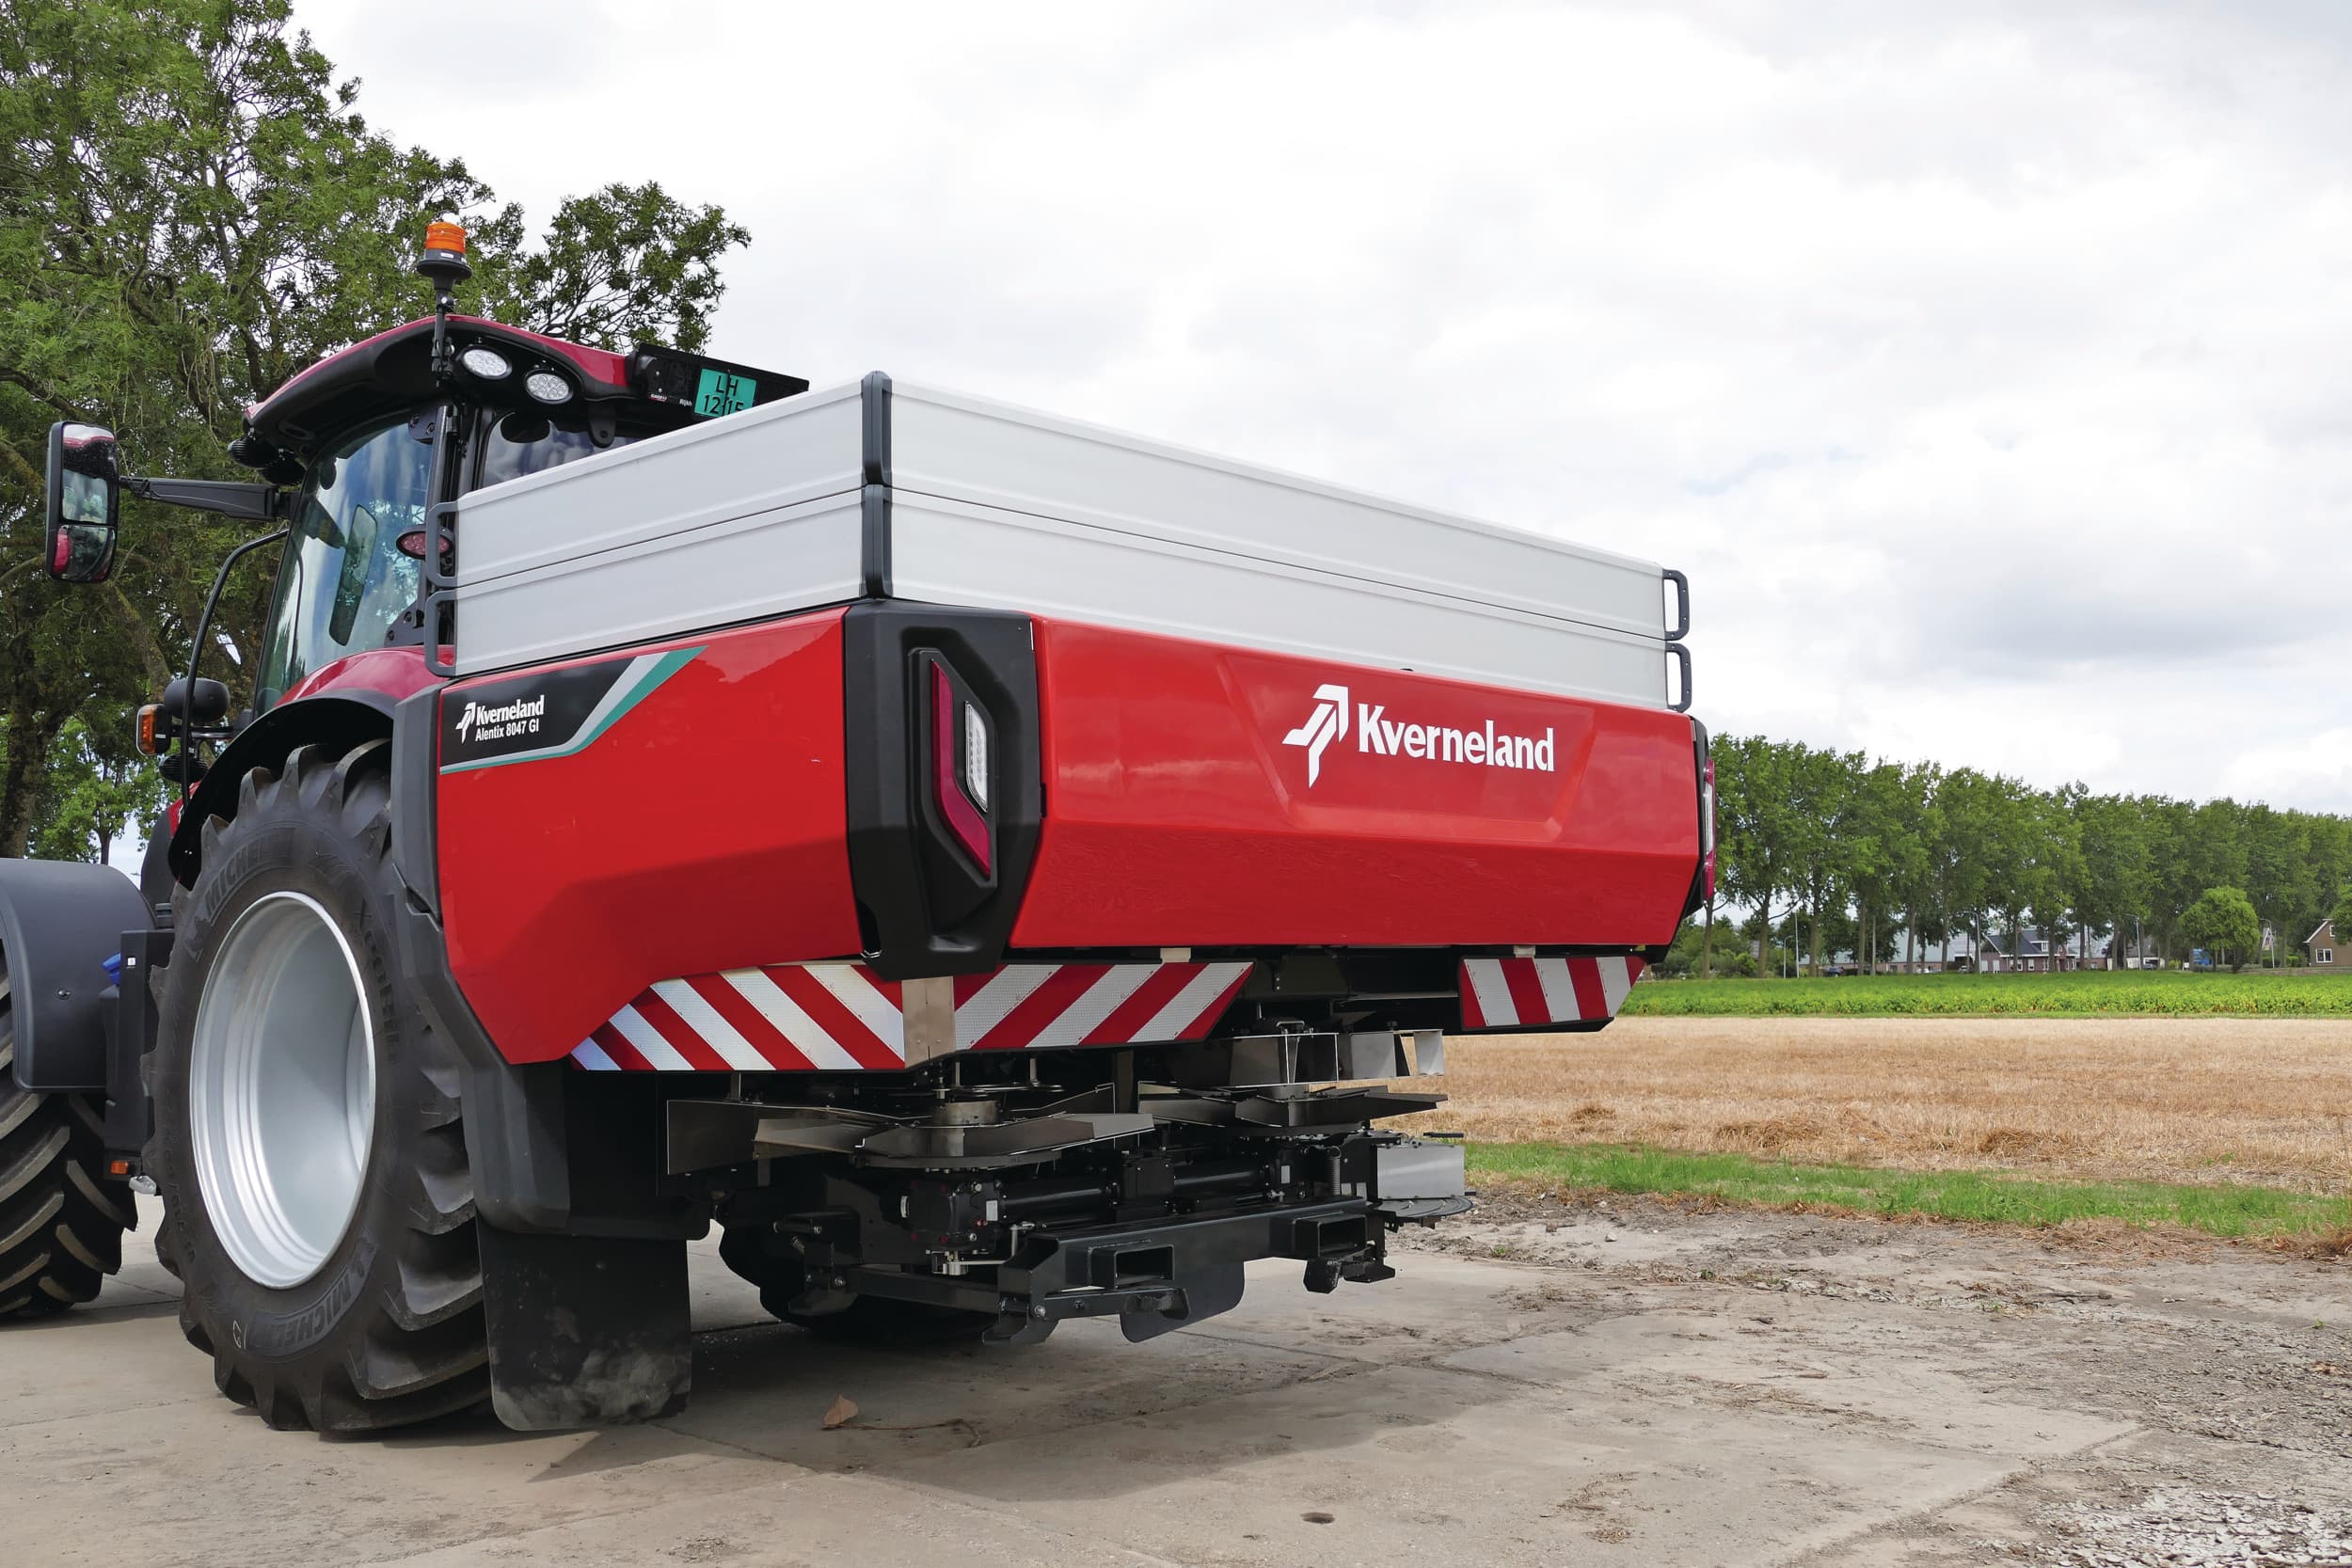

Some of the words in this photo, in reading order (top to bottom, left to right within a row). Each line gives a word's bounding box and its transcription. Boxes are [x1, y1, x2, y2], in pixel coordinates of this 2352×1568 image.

[715, 374, 739, 397] LH
[476, 695, 545, 726] Kverneland
[475, 725, 504, 742] Alentix
[506, 721, 527, 736] 8047
[1358, 704, 1555, 771] Kverneland
